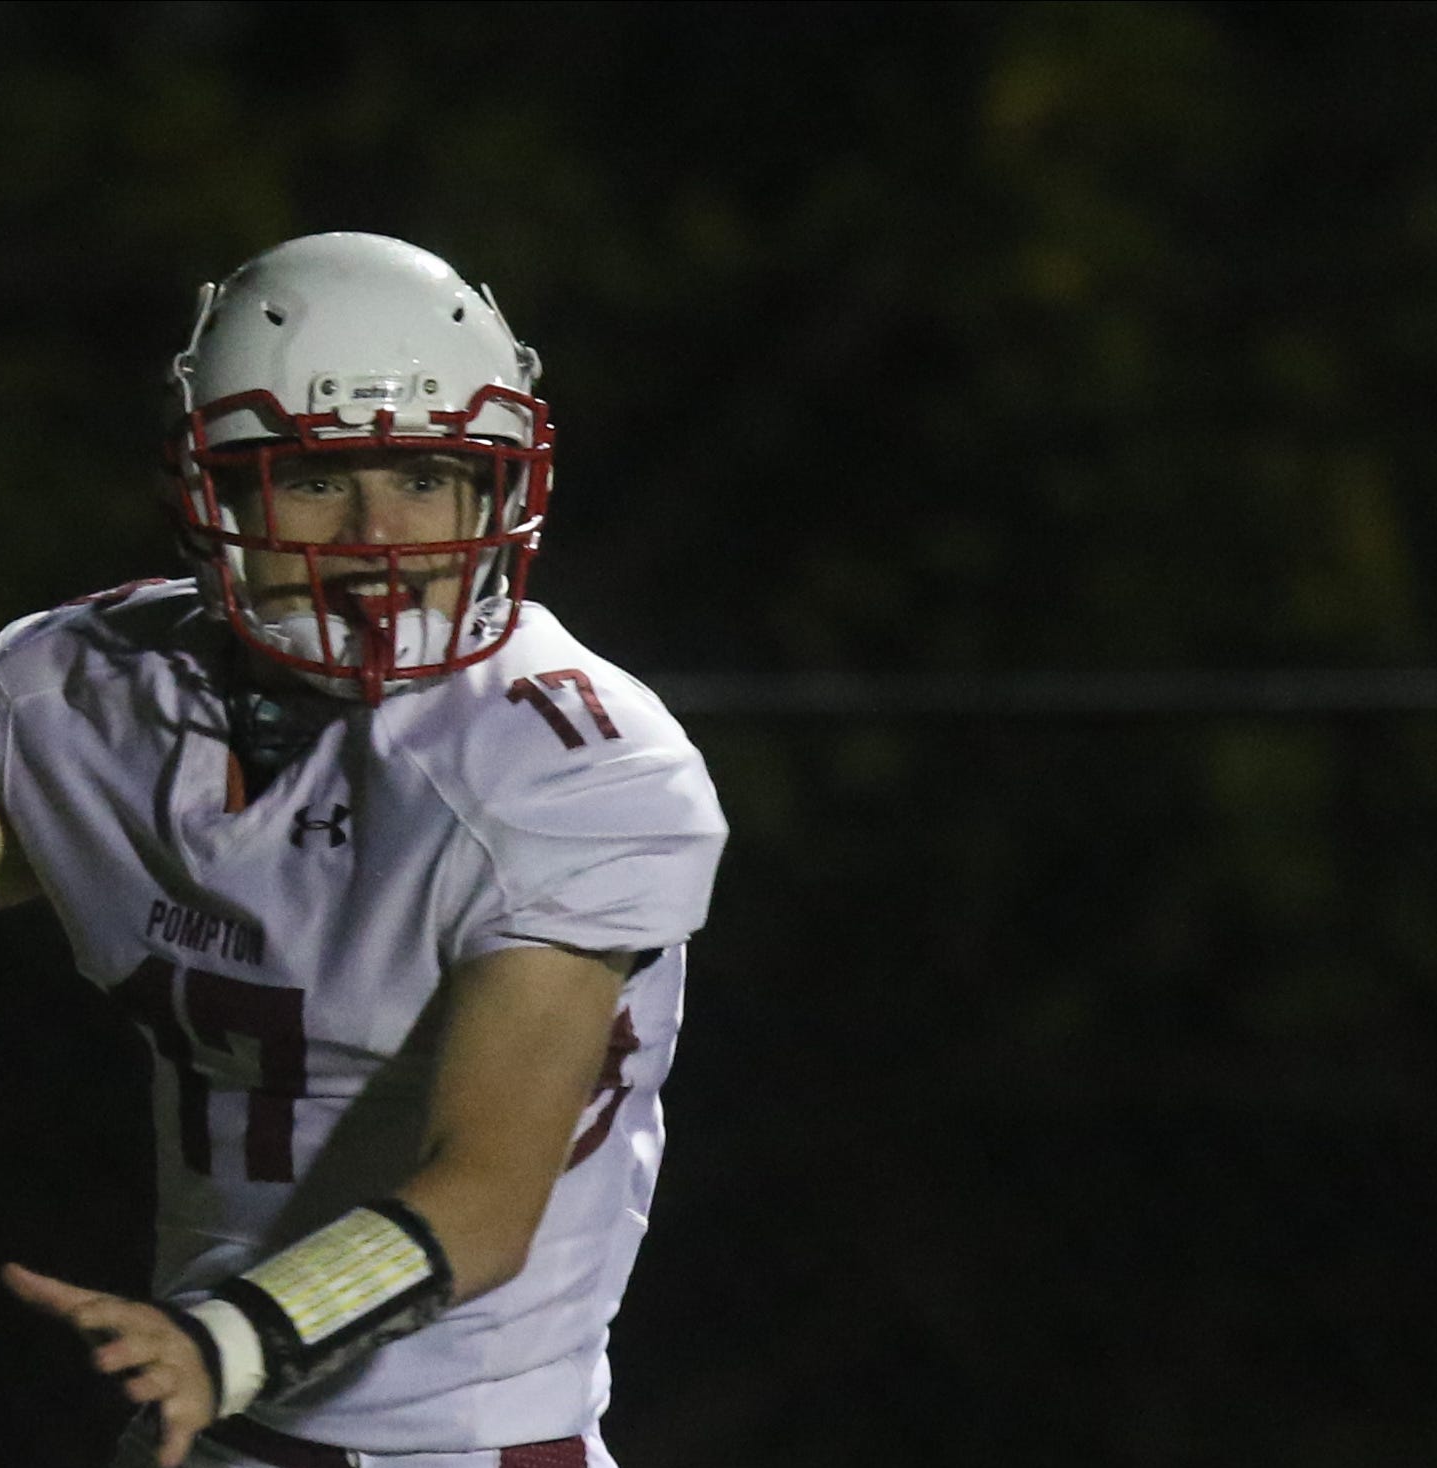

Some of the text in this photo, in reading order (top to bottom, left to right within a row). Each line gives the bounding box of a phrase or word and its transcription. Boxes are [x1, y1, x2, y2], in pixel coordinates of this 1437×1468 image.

[506, 668, 622, 751] 17
[145, 899, 265, 966] POMPTON
[107, 954, 307, 1184] 17
